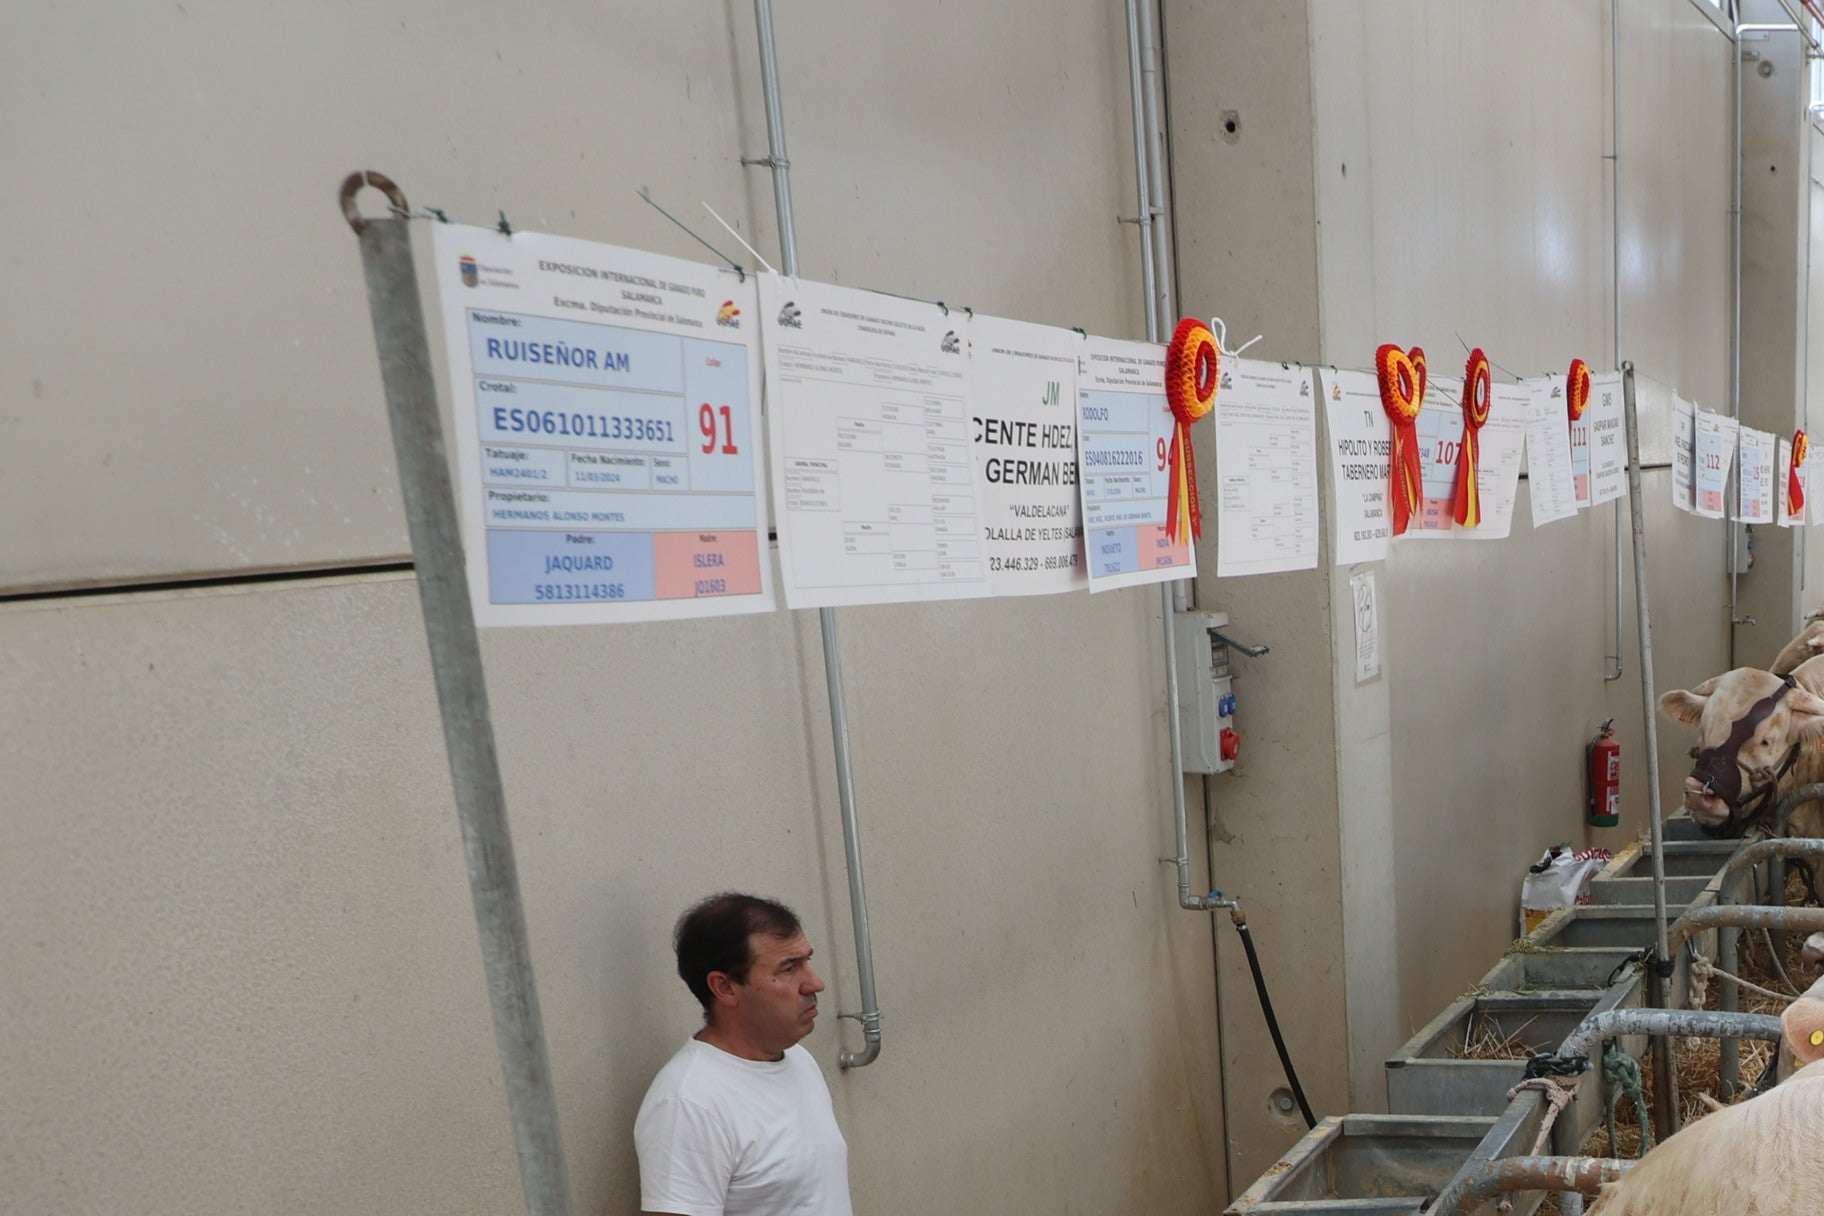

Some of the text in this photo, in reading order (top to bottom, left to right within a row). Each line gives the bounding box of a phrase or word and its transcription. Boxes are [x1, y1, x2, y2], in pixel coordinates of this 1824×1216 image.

[601, 270, 657, 289] INTERNACIONAL
[659, 280, 667, 290] DE
[621, 290, 663, 305] SALAMANCA
[553, 297, 587, 311] Excma.
[590, 301, 633, 317] Diputación
[634, 307, 665, 322] Provincial
[472, 312, 522, 328] Nombre:
[487, 338, 630, 373] RUISEÑOR AM
[479, 381, 517, 394] Crotal:
[1042, 381, 1060, 406] JM
[493, 407, 674, 442] ES061011333651
[1364, 410, 1374, 428] TN
[699, 403, 738, 455] 91
[1572, 427, 1587, 447] 111
[486, 448, 528, 462] Tatuaje:
[1338, 440, 1366, 456] HIPOLITO
[1367, 441, 1373, 456] Y
[1436, 440, 1463, 465] 107
[571, 453, 597, 465] Fecha
[1707, 453, 1720, 470] 112
[985, 457, 1060, 485] GERMAN
[1342, 464, 1378, 481] TABERNERO
[488, 490, 550, 503] Propietario:
[493, 509, 625, 522] HERMANOS ALONSO MONTES
[566, 533, 595, 545] Padre:
[1025, 528, 1035, 541] DE
[545, 555, 613, 574] JAQUARD
[693, 553, 725, 568] ISLERA
[535, 583, 625, 600] 5813114386
